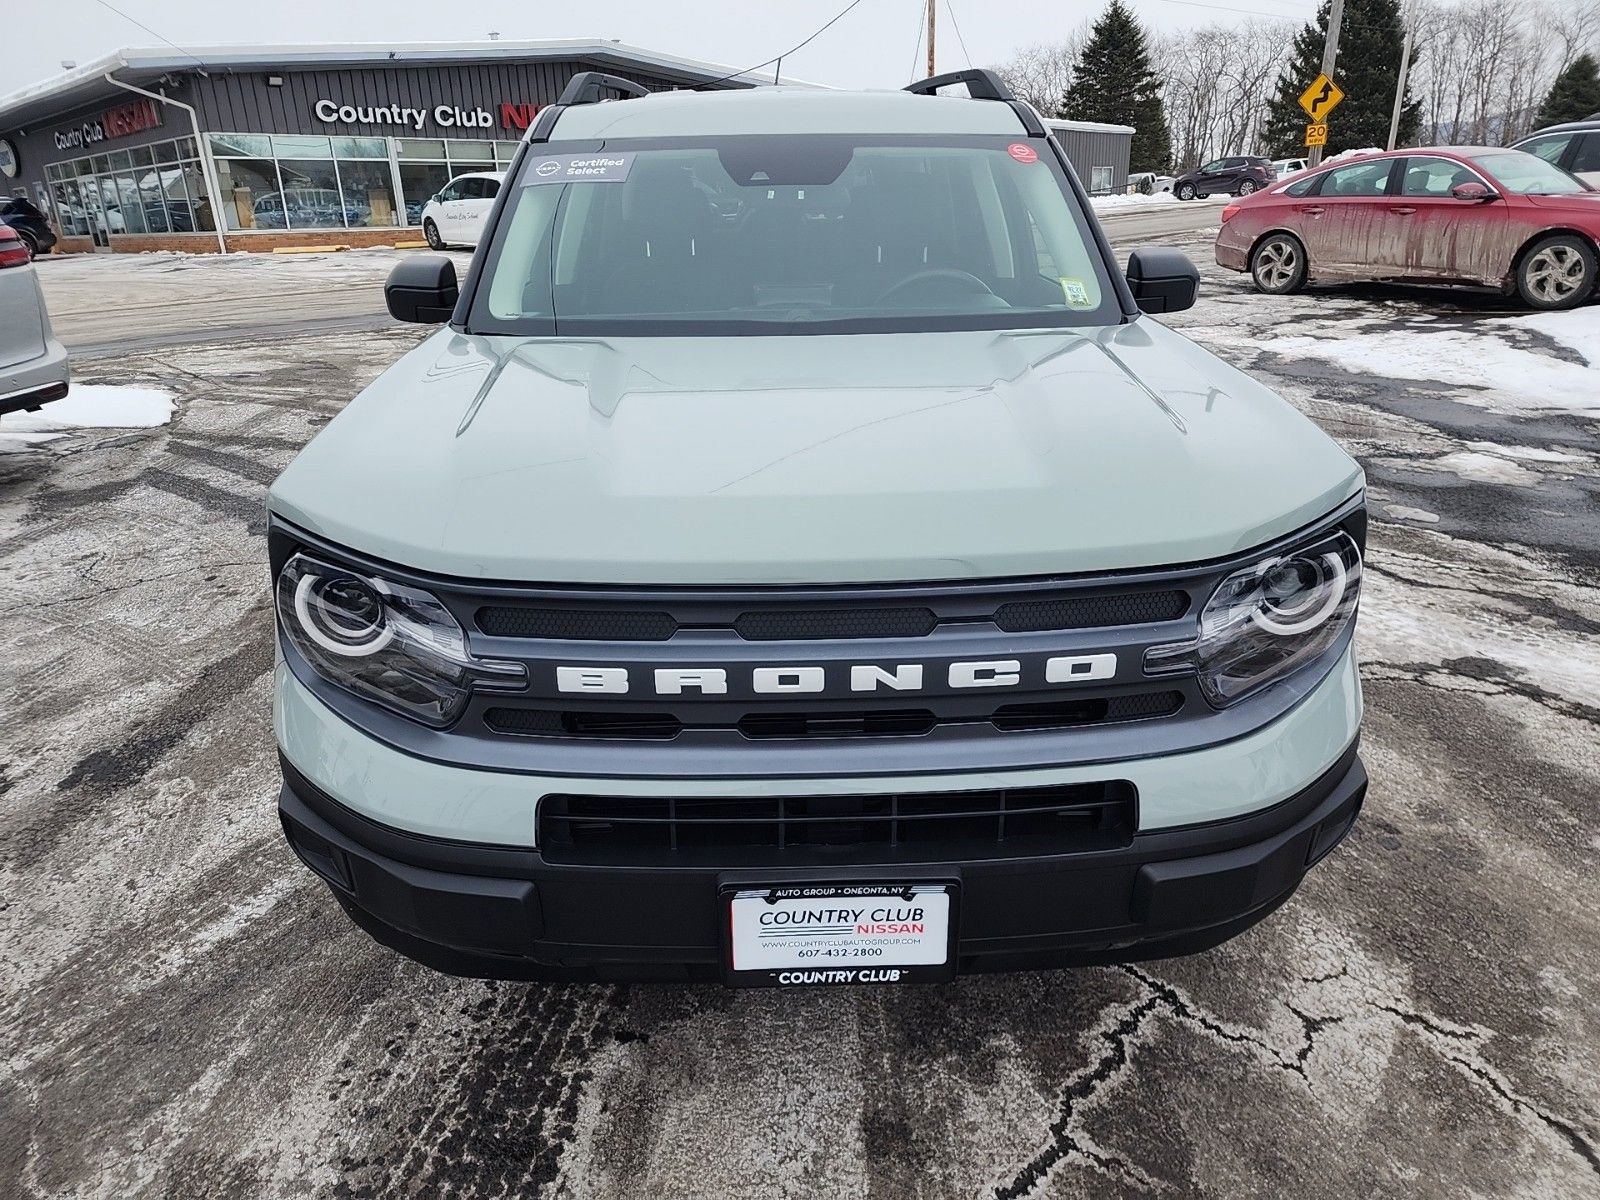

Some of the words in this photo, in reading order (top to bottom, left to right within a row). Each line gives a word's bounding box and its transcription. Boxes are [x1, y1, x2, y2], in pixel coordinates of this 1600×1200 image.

[315, 99, 426, 130] Country
[434, 105, 493, 128] Club
[54, 128, 83, 149] Country
[82, 120, 103, 143] Club
[1308, 127, 1326, 138] 20
[570, 159, 625, 168] Certified
[566, 167, 607, 176] Select
[556, 653, 1117, 694] BRONCO
[775, 889, 801, 897] AUTO
[803, 888, 836, 896] GROUP
[843, 887, 890, 895] ONEONTA,
[760, 909, 865, 925] COUNTRY
[870, 908, 924, 922] CLUB
[857, 923, 924, 934] NISSAN
[761, 938, 921, 948] WWW.COUNTRYCLUBAUTOGROUP.COM
[798, 948, 883, 958] 607-432-2800
[778, 970, 857, 984] COUNTRY
[858, 969, 901, 982] CLUB
